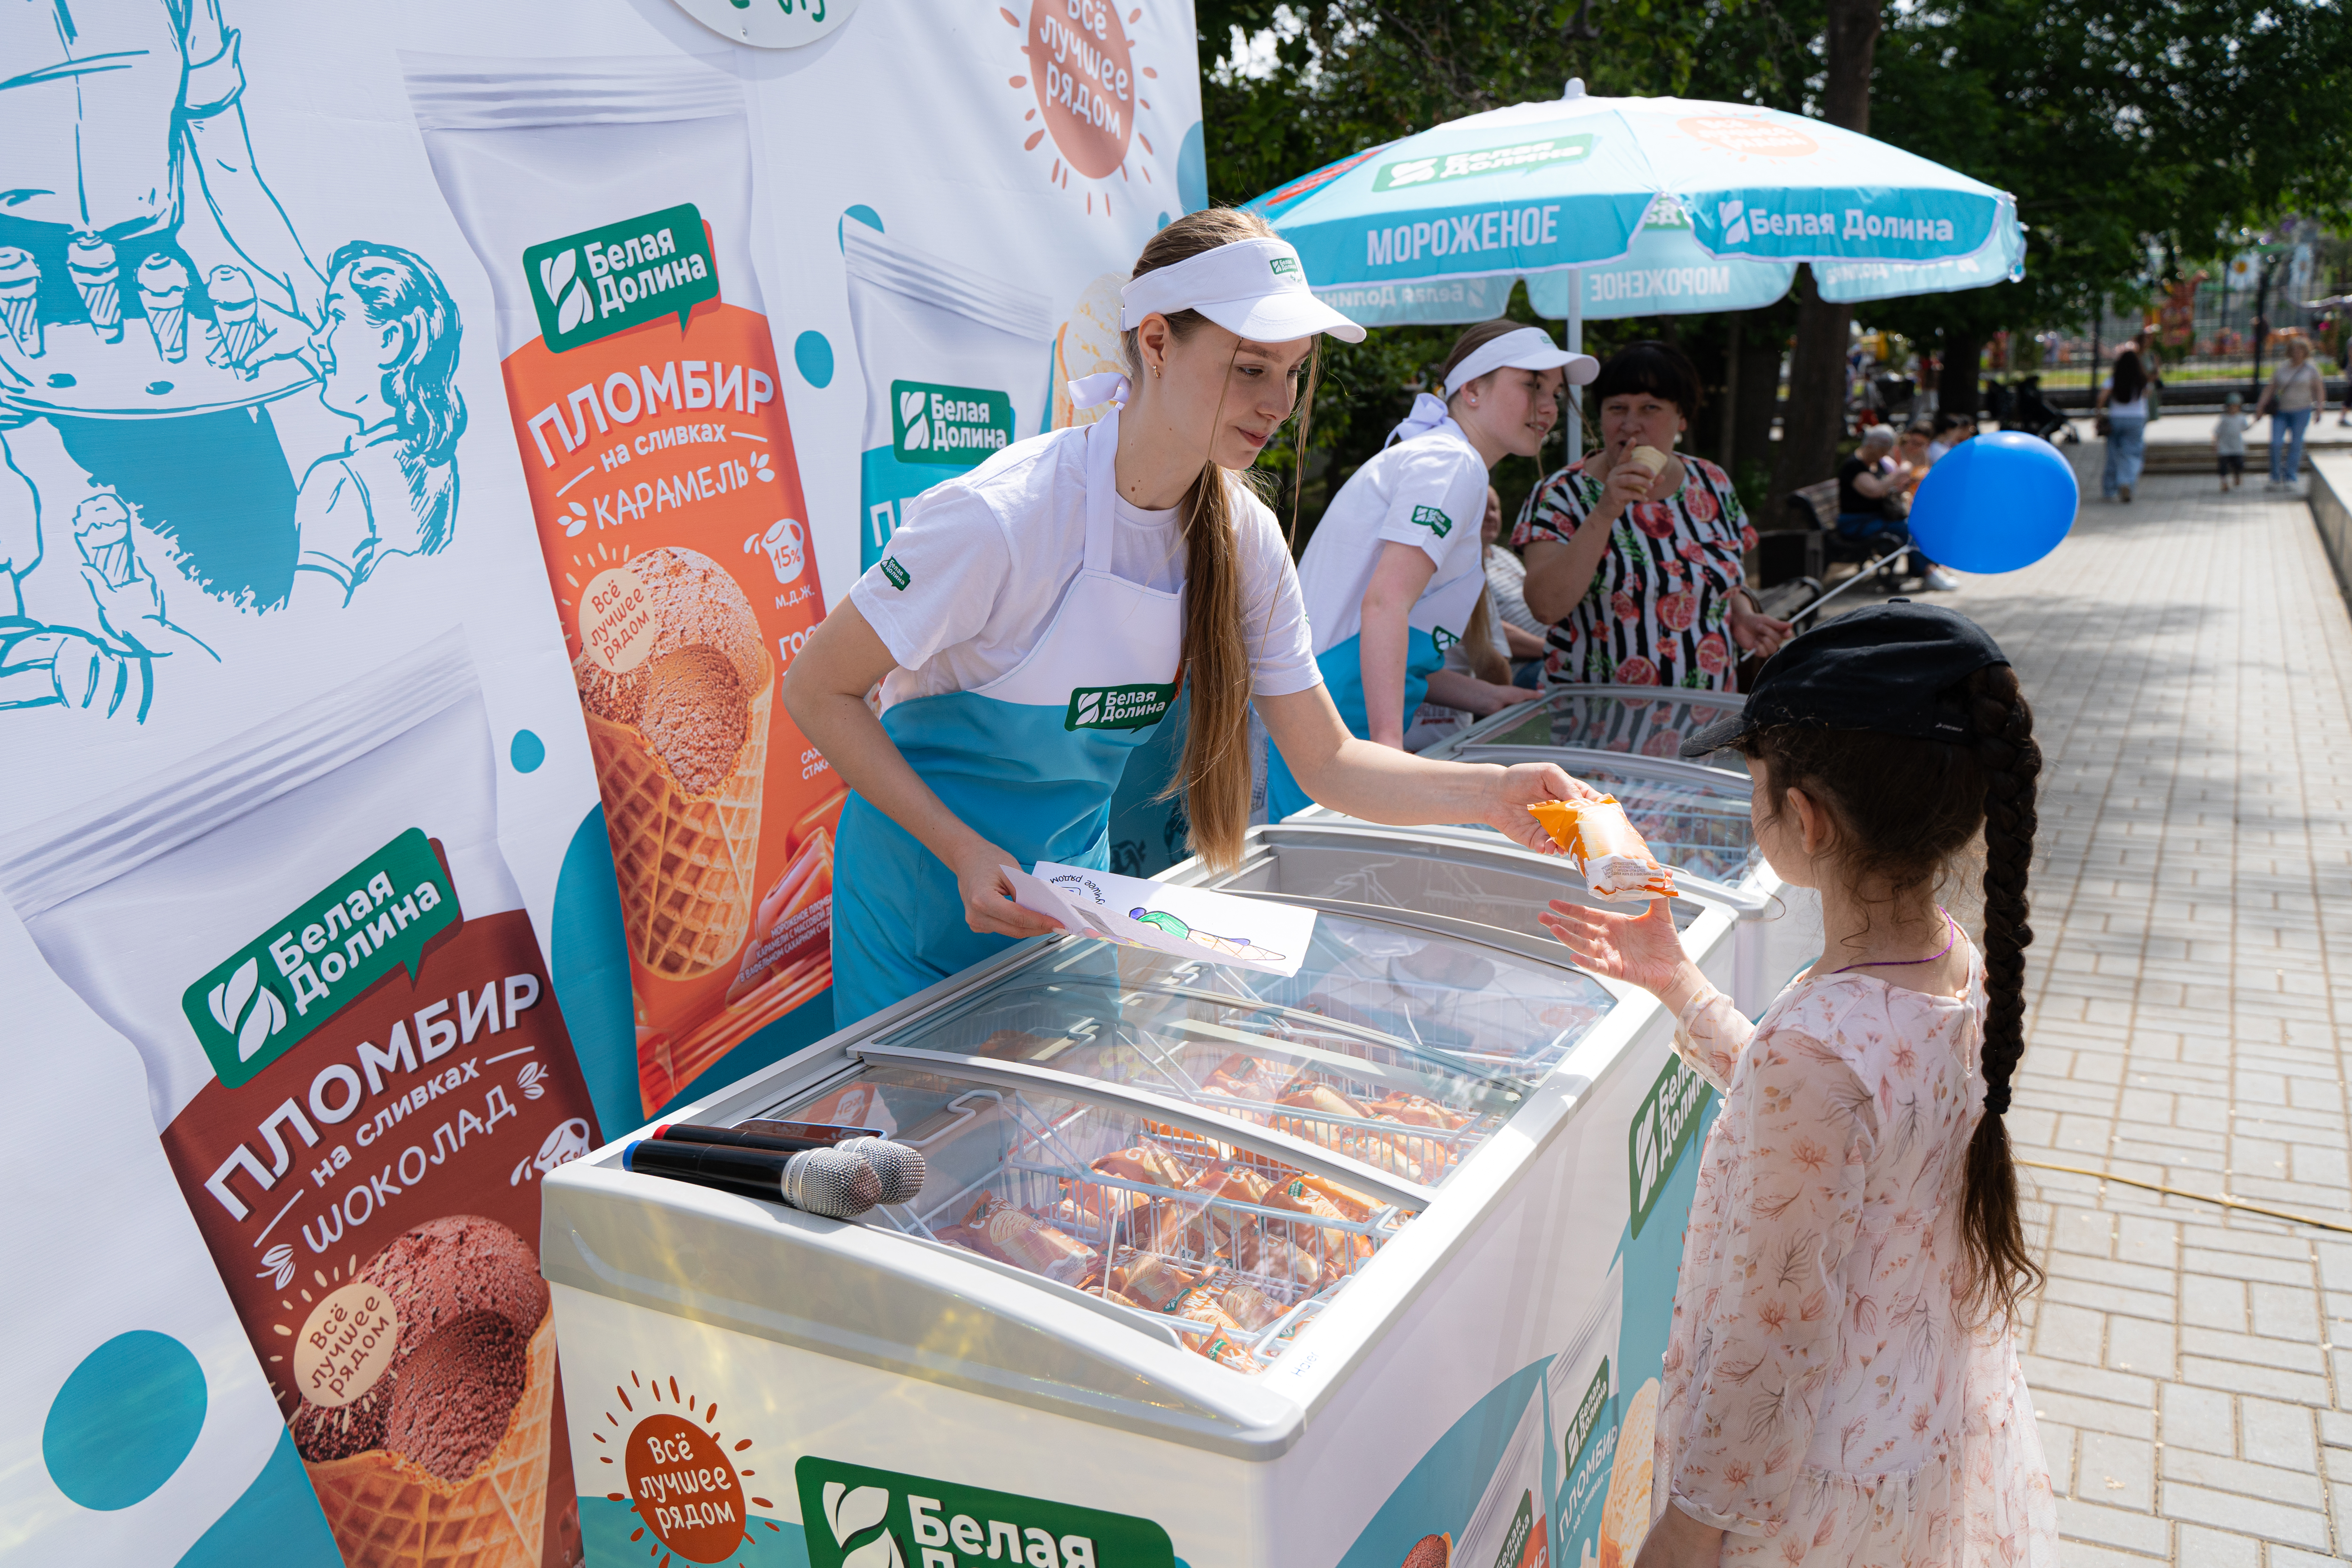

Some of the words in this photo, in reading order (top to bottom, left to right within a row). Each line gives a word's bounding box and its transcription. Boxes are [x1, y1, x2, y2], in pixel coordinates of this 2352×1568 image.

[1040, 15, 1128, 101] лучшее
[1046, 61, 1120, 139] рядом
[1439, 146, 1584, 178] Долина
[1445, 142, 1555, 167] Белая
[1367, 206, 1561, 266] МОРОЖЕНОЕ
[1749, 208, 1835, 236] Белая
[1843, 208, 1954, 241] Долина
[584, 228, 676, 278] Белая
[597, 253, 708, 318] Долина
[527, 360, 774, 469] ПЛОМБИР
[930, 394, 990, 423] Белая
[601, 444, 630, 472] на
[635, 423, 727, 455] сливках
[932, 421, 1008, 452] Долина
[593, 459, 748, 530] КАРАМЕЛЬ
[774, 545, 801, 569] 15%
[885, 565, 905, 585] Долина
[889, 559, 904, 577] Белая
[590, 587, 644, 647] лучшее
[592, 580, 621, 614] Всё
[603, 610, 650, 666] рядом
[1100, 701, 1166, 723] Долина
[1105, 691, 1157, 706] Белая
[1050, 875, 1083, 883] рядом
[268, 869, 395, 977] Белая
[756, 933, 789, 959] КАРАМЕЛИ
[789, 930, 794, 939] С
[794, 909, 825, 935] МАССОВОЙ
[771, 907, 809, 938] МОРОЖЕНОЕ
[288, 881, 442, 1016] Долина
[739, 972, 745, 982] В
[745, 948, 784, 979] ВАФЕЛЬНОМ
[784, 930, 817, 954] САХАРНОМ
[204, 973, 539, 1222] ПЛОМБИР
[311, 1145, 352, 1188] на
[356, 1057, 479, 1147] сливках
[302, 1085, 517, 1253] ШОКОЛАД
[309, 1302, 348, 1350] Всё
[310, 1295, 381, 1389] лучшее
[329, 1316, 390, 1398] рядом
[1291, 1352, 1319, 1377] Haier
[1579, 1377, 1600, 1428] Белая
[1580, 1381, 1606, 1447] Долина
[647, 1432, 693, 1464] Всё
[640, 1466, 731, 1503] лучшее
[1559, 1425, 1618, 1544] ПЛОМБИР
[1573, 1514, 1581, 1534] на
[1581, 1472, 1604, 1515] сливках
[655, 1501, 736, 1538] рядом
[907, 1494, 1097, 1568] Белая
